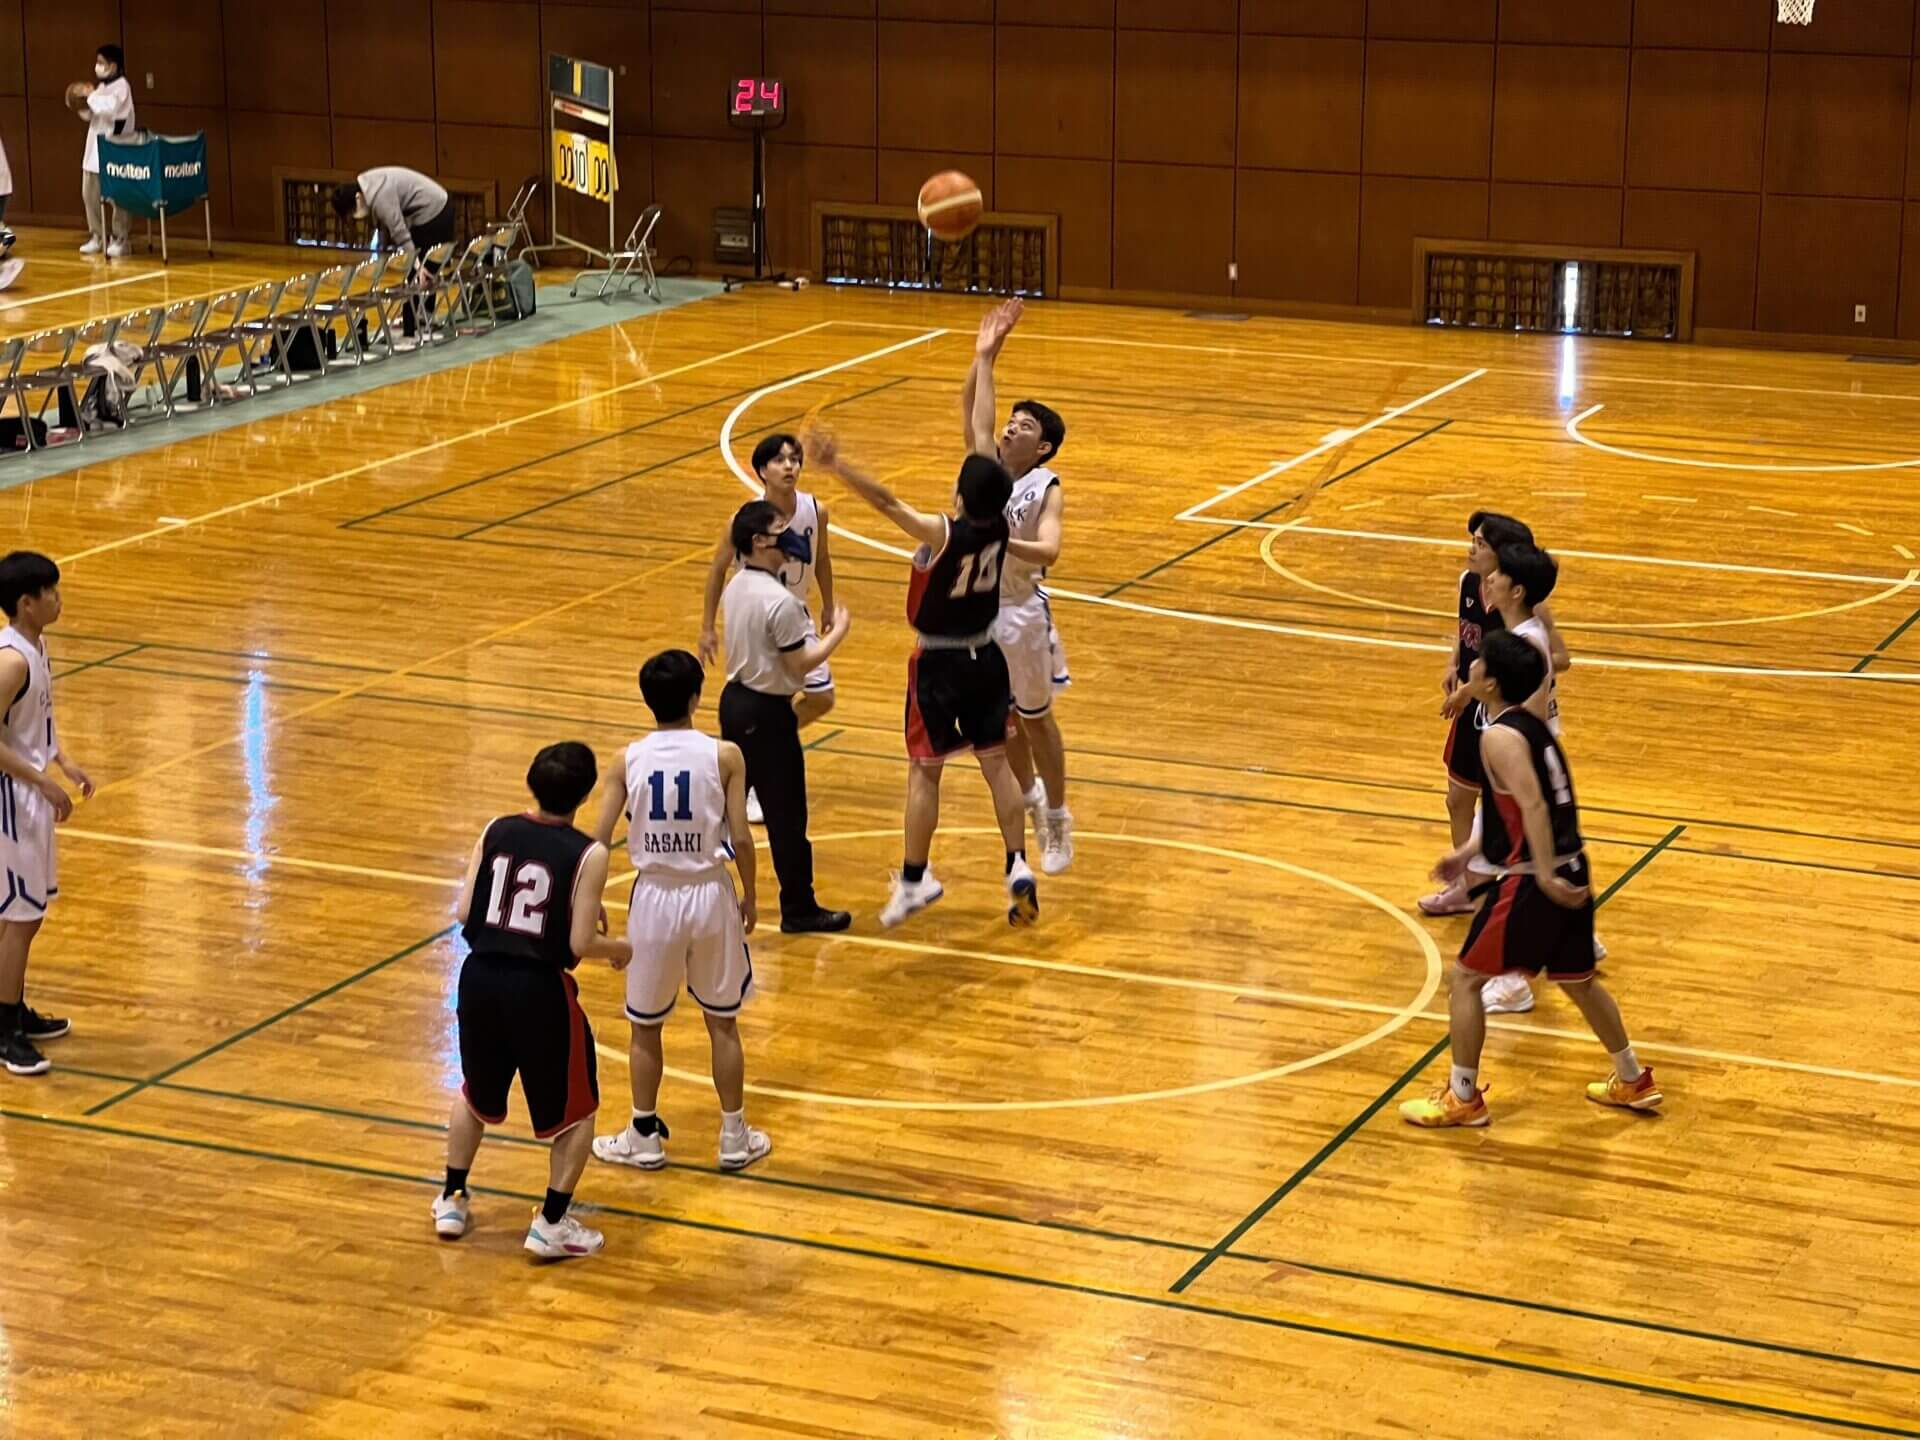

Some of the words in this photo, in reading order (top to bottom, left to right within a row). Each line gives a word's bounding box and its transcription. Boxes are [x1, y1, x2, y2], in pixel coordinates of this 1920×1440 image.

[736, 80, 779, 112] 24
[106, 161, 151, 181] molten
[164, 161, 202, 179] molten
[575, 148, 586, 189] 10
[950, 541, 1002, 598] 10
[647, 770, 693, 821] 11
[644, 832, 702, 853] SASAKI
[486, 855, 552, 936] 12
